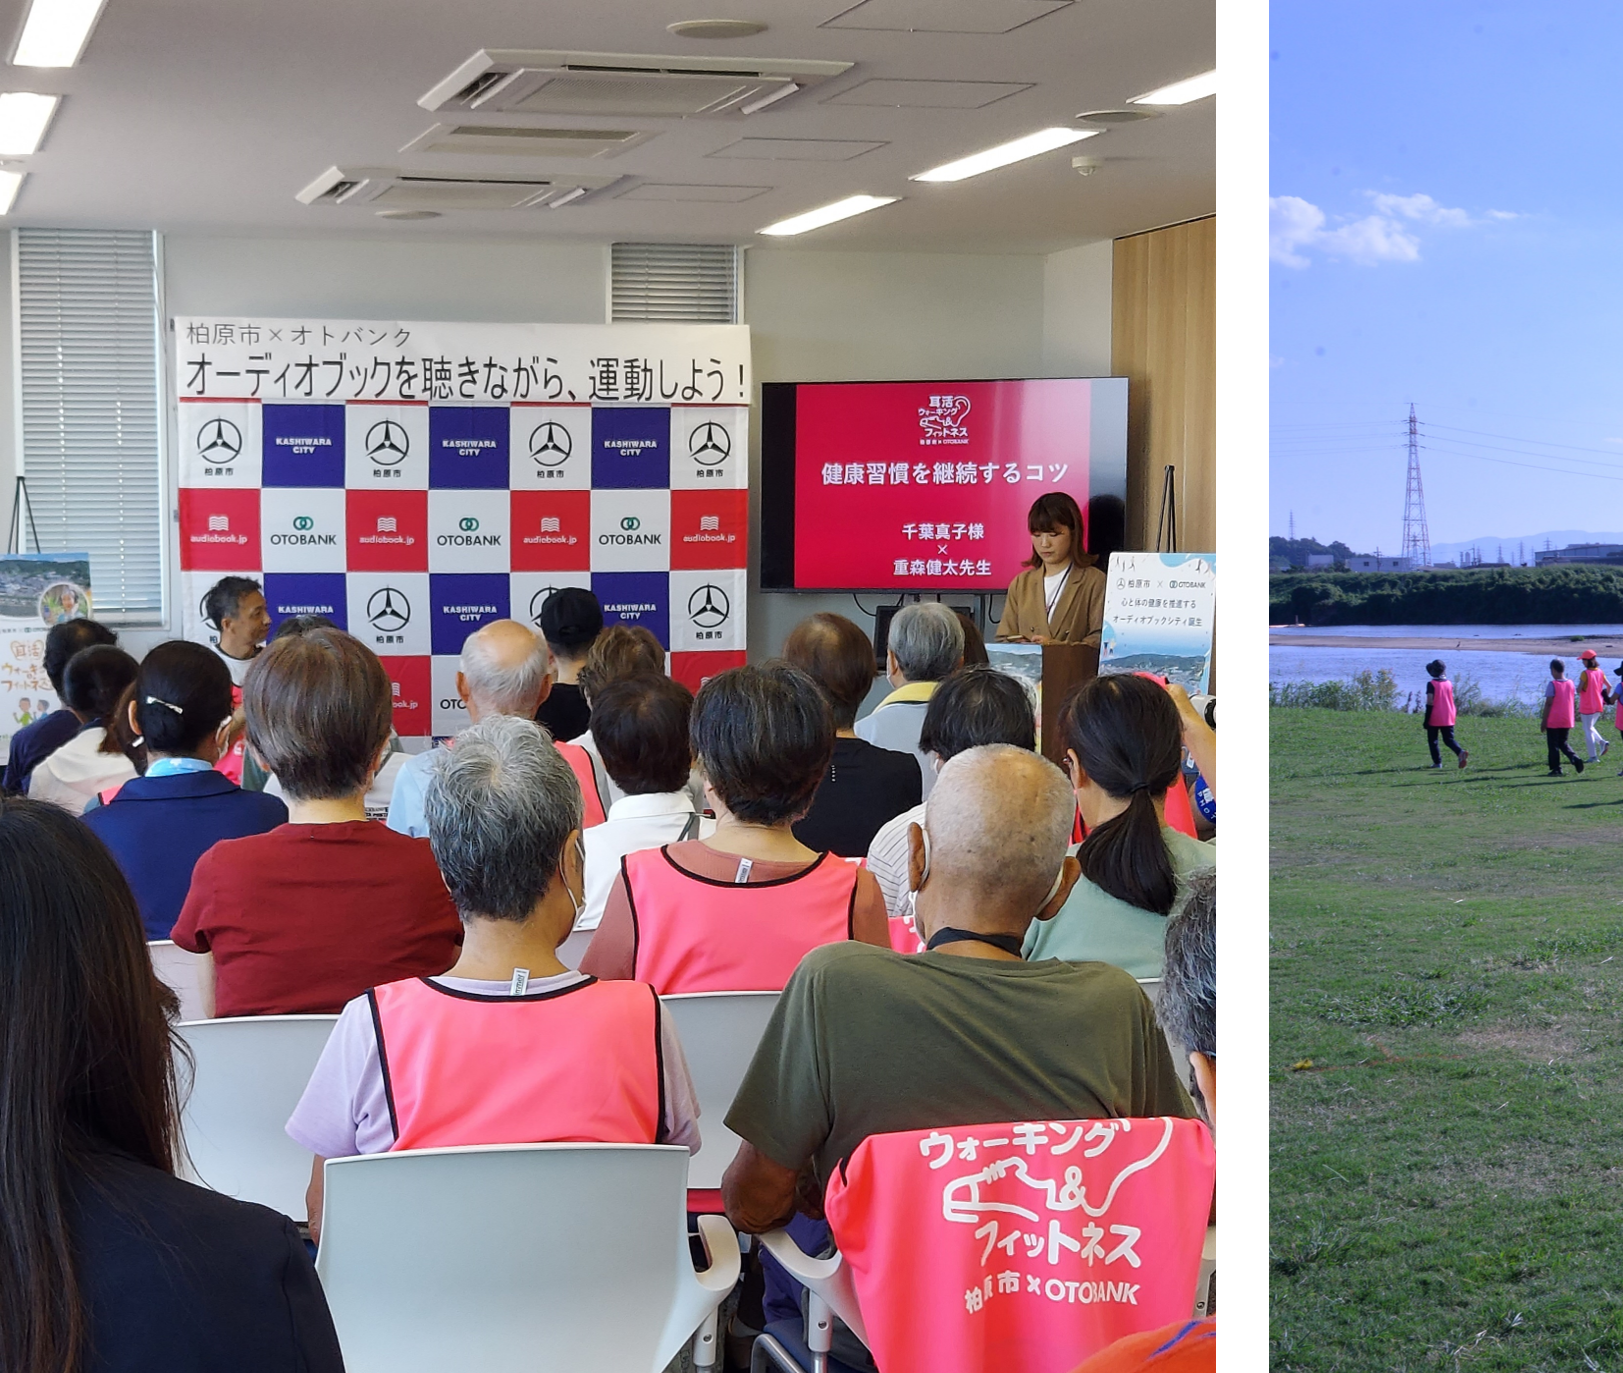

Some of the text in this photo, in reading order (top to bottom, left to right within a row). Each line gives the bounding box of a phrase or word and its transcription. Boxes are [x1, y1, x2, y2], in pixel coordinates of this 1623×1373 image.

[929, 395, 954, 408] 耳活
[924, 427, 968, 438] フィットネス
[276, 437, 332, 446] KASHIWARA
[442, 439, 497, 448] KASHIWARA
[604, 440, 657, 448] KASHIWARA
[293, 446, 315, 454] CITY
[459, 448, 480, 457] CITY
[620, 448, 641, 457] CITY
[204, 467, 234, 476] 柏原市
[373, 469, 402, 478] 柏原市
[536, 469, 565, 479] 柏原市
[696, 469, 724, 478] 柏原市
[821, 462, 1069, 485] 健康習慣を継続するコツ
[901, 522, 985, 540] 千葉真子様
[190, 533, 248, 544] audiobook.jp
[270, 534, 337, 546] OTOBANK
[359, 535, 415, 545] audiobook.jp
[436, 535, 502, 546] OTOBANK
[523, 535, 577, 545] audiobook.jp
[598, 534, 662, 545] OTOBANK
[683, 533, 736, 543] audiobook.jp
[893, 558, 992, 576] 重森健太先生
[278, 605, 334, 614] KASHIWARA
[443, 605, 497, 614] KASHIWARA
[604, 604, 657, 612] KASHIWARA
[459, 613, 481, 622] CITY
[620, 612, 641, 620] CITY
[376, 635, 405, 644] 柏原市
[695, 631, 723, 640] 柏原市
[919, 1122, 1119, 1170] ウォーキング
[975, 1219, 1142, 1268] フィットネス
